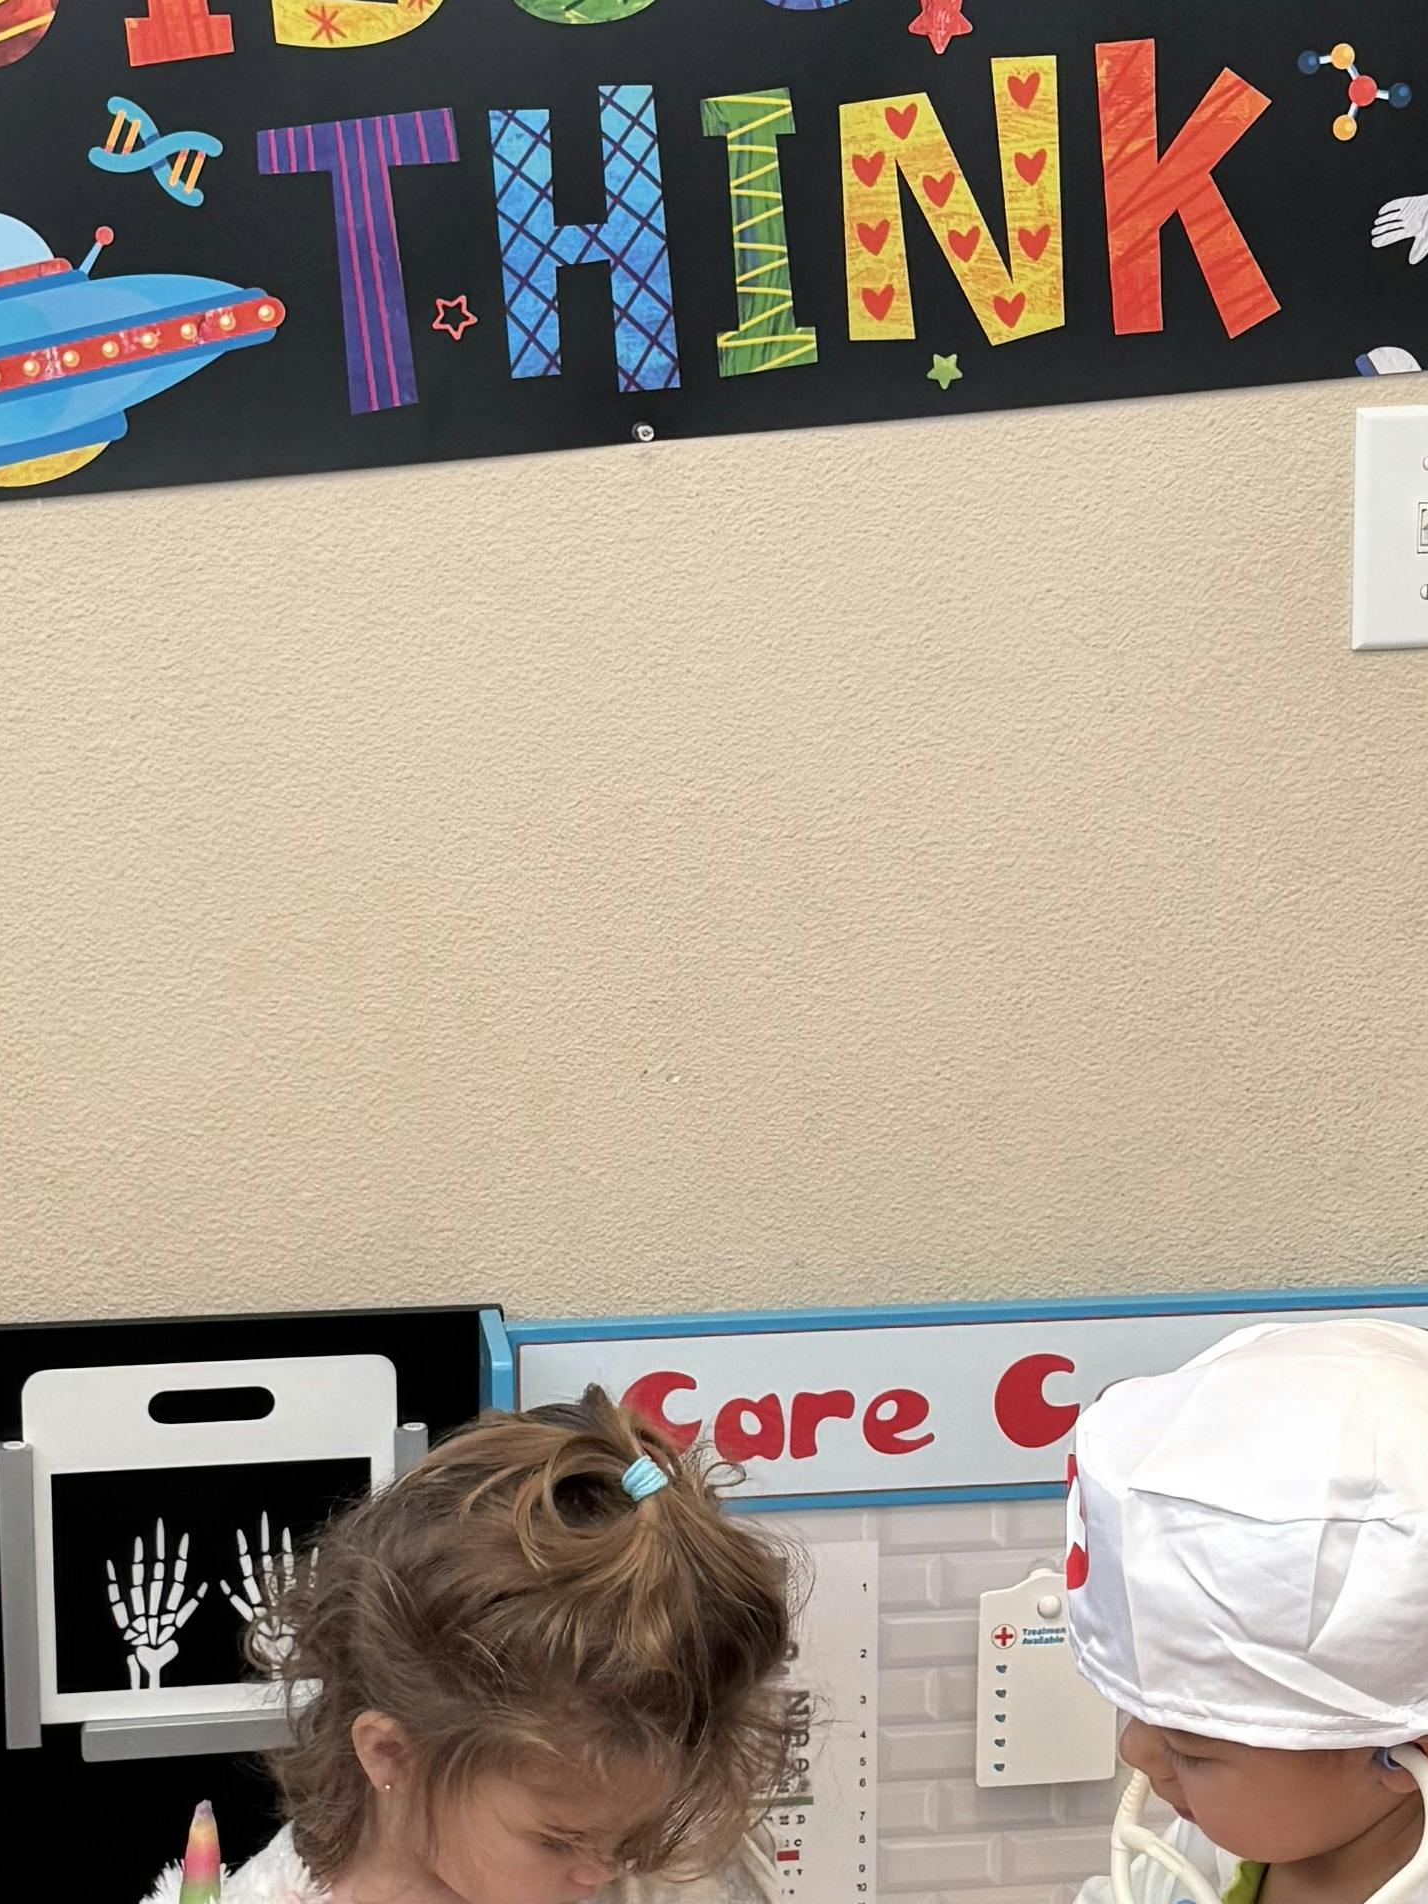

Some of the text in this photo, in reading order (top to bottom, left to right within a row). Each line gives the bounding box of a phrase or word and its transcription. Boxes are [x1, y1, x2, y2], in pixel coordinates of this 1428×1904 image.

[256, 37, 1281, 415] THINK
[621, 1370, 935, 1463] Care
[862, 1582, 868, 1592] 1
[860, 1649, 867, 1658] 2
[860, 1695, 867, 1705] 3
[860, 1730, 866, 1739] 4
[859, 1757, 866, 1767] 5
[859, 1778, 866, 1787] 6
[859, 1811, 866, 1820] 7
[859, 1835, 866, 1844] 8
[858, 1864, 866, 1873] 9
[857, 1882, 867, 1892] 10
